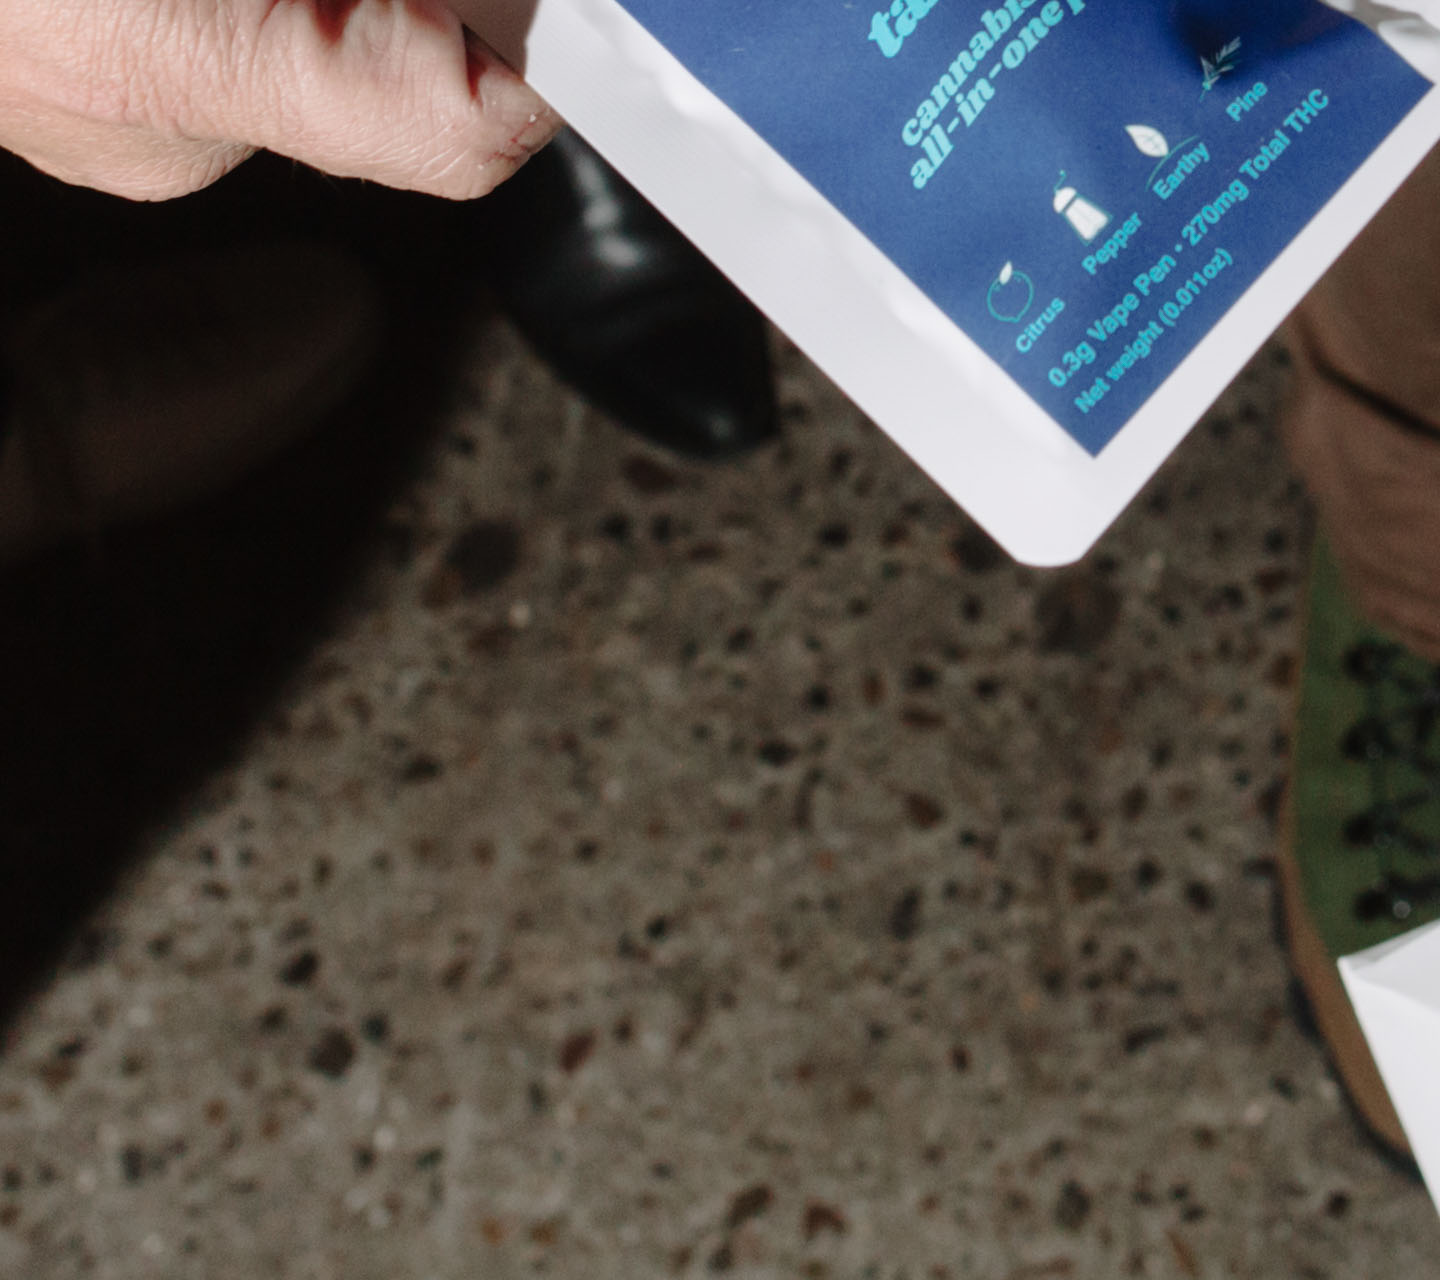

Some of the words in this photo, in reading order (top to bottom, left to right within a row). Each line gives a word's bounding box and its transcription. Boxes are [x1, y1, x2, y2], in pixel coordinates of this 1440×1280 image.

[909, 0, 1064, 190] all-in-one
[1225, 81, 1269, 122] Pine
[1152, 142, 1211, 200] Earthy
[1047, 340, 1097, 388] 0.3g
[1086, 292, 1141, 342] Vape
[1132, 253, 1178, 296] Pen
[1181, 178, 1250, 246] 270mg
[1238, 128, 1292, 180] Total
[1282, 88, 1330, 133] THC
[1081, 211, 1143, 275] Pepper
[1015, 297, 1066, 354] Citrus
[1073, 376, 1111, 414] Net
[1106, 320, 1165, 381] weight
[1157, 246, 1234, 328] (0.011oz)
